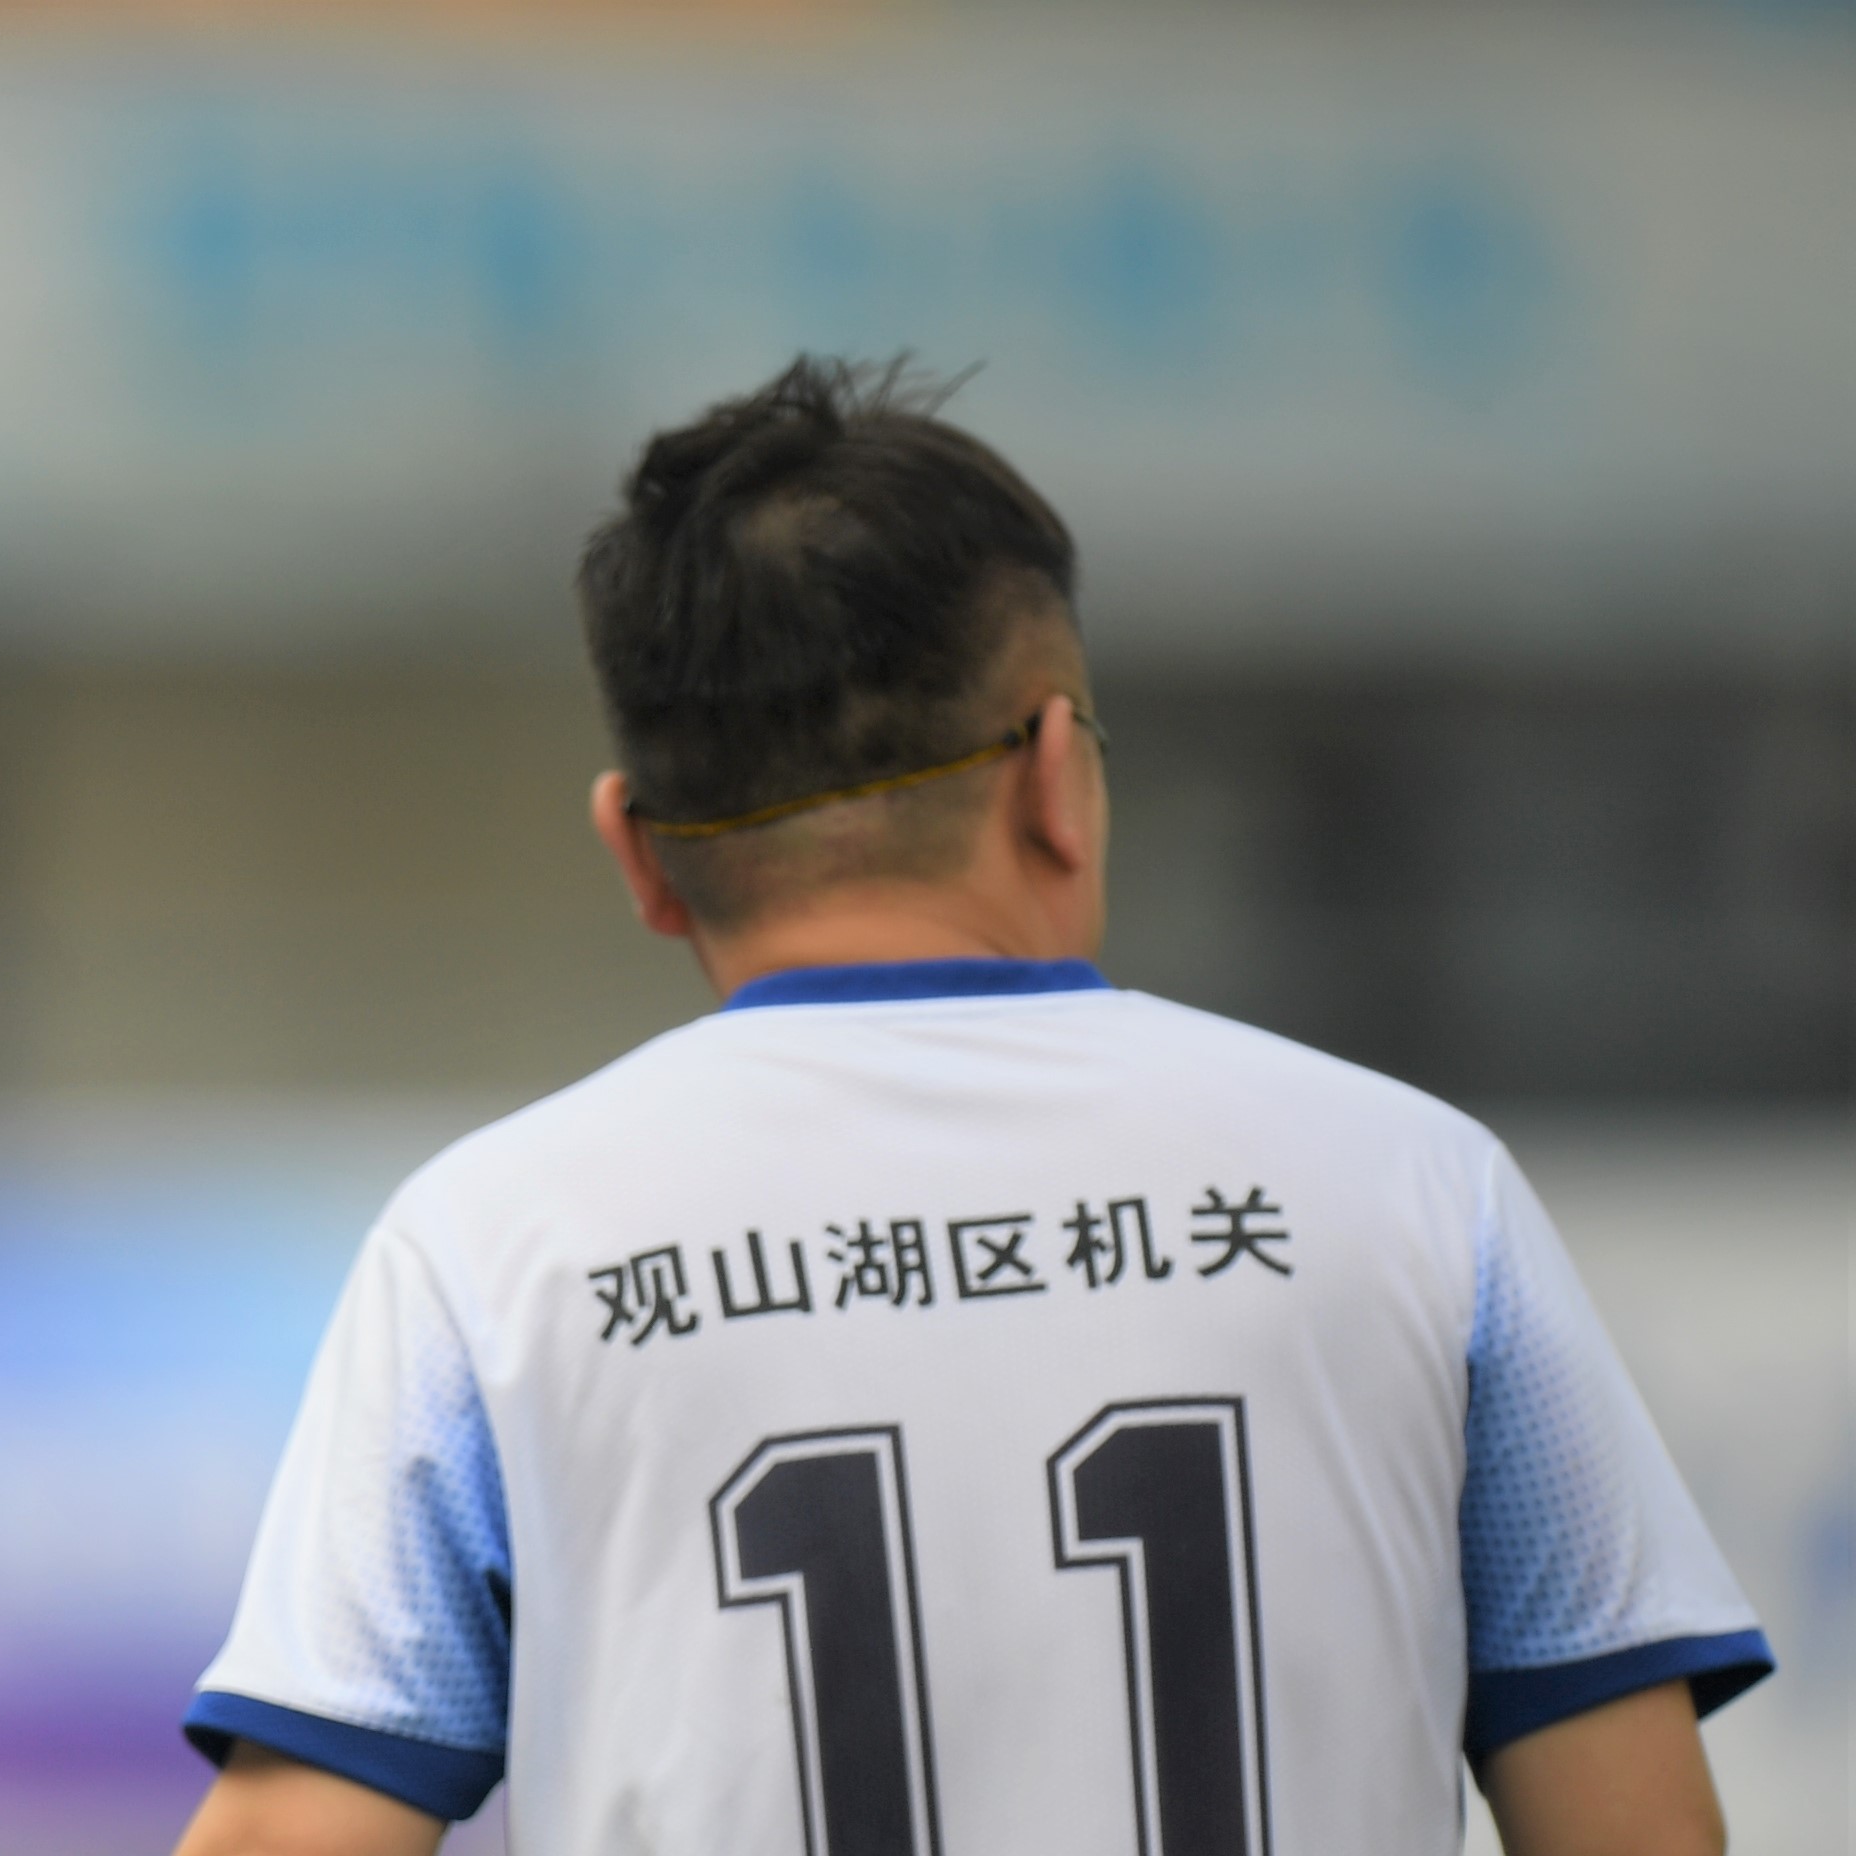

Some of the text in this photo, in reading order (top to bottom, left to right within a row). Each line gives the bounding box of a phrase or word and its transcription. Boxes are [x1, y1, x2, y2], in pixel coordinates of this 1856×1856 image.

[587, 1185, 1296, 1347] 观山湖区机关
